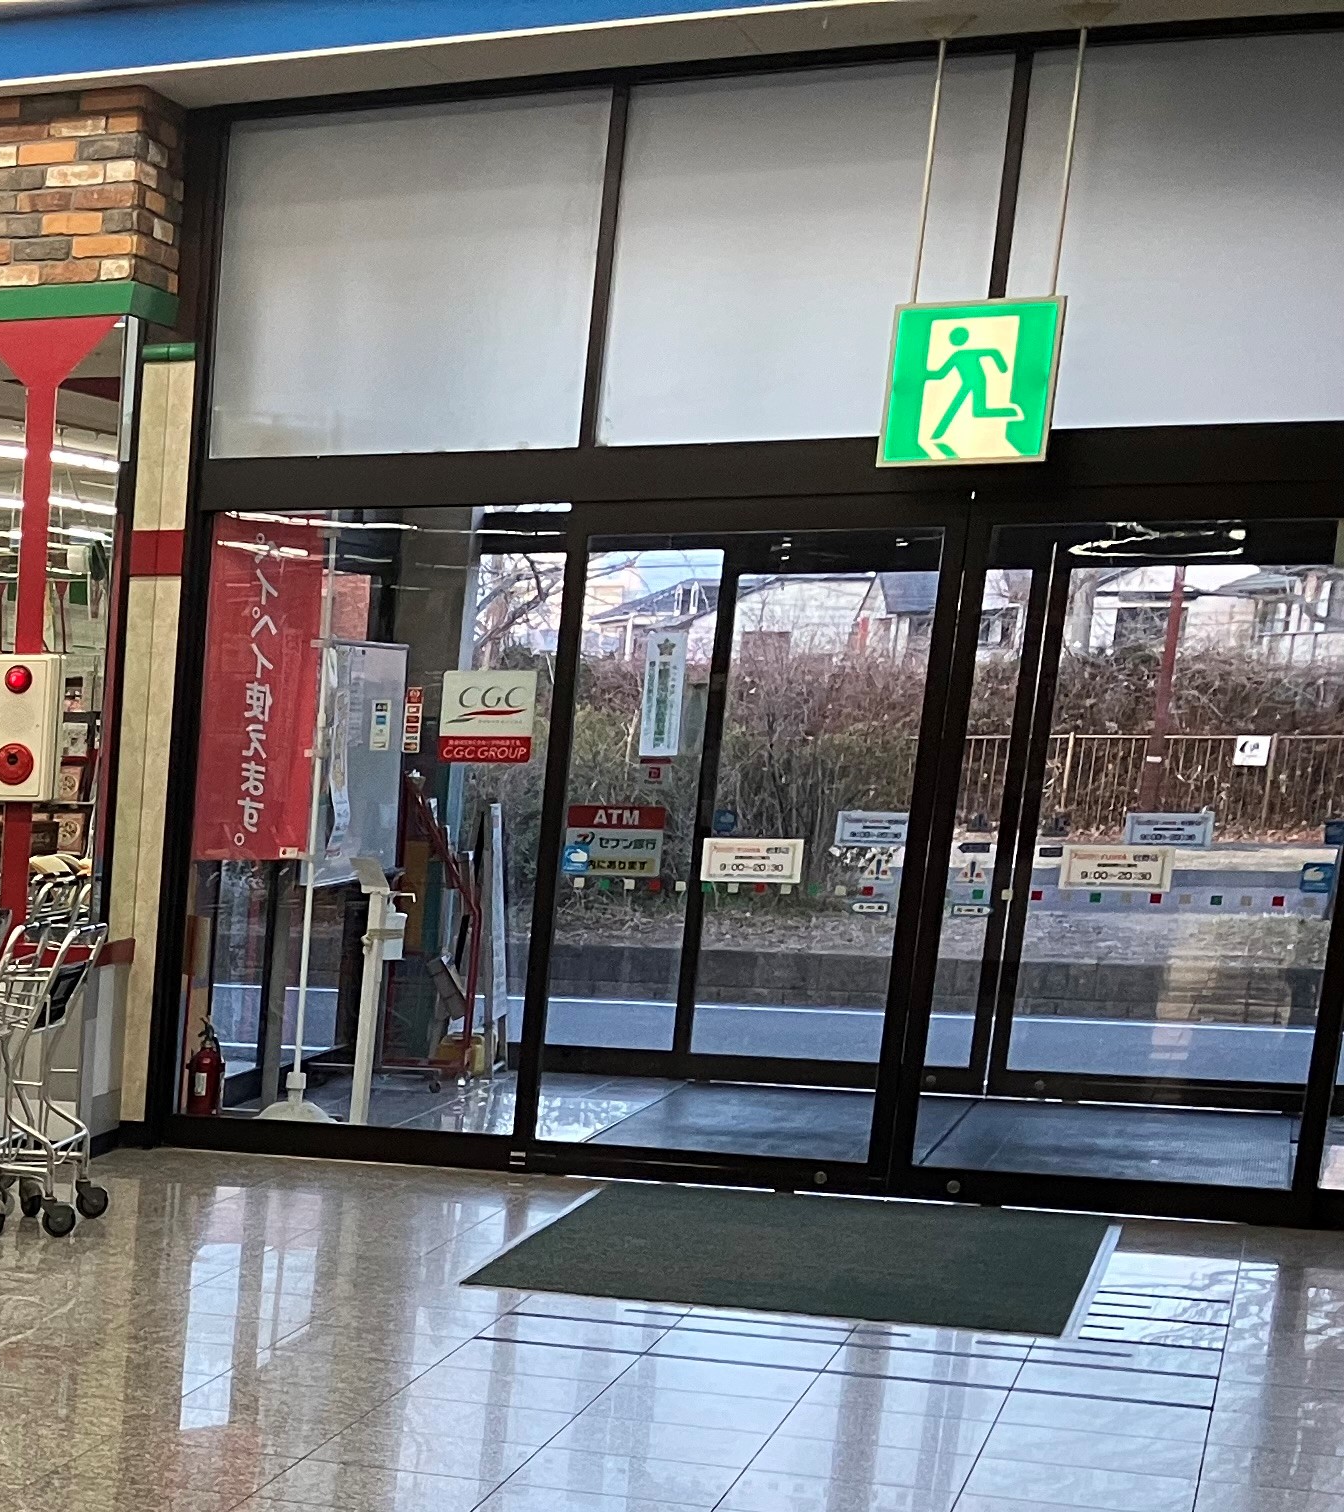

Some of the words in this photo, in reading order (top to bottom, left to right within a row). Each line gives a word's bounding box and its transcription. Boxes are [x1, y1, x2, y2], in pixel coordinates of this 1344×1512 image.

[459, 686, 527, 708] CGC
[443, 747, 475, 759] CGC
[477, 747, 527, 759] GROUP
[593, 809, 640, 826] ATM
